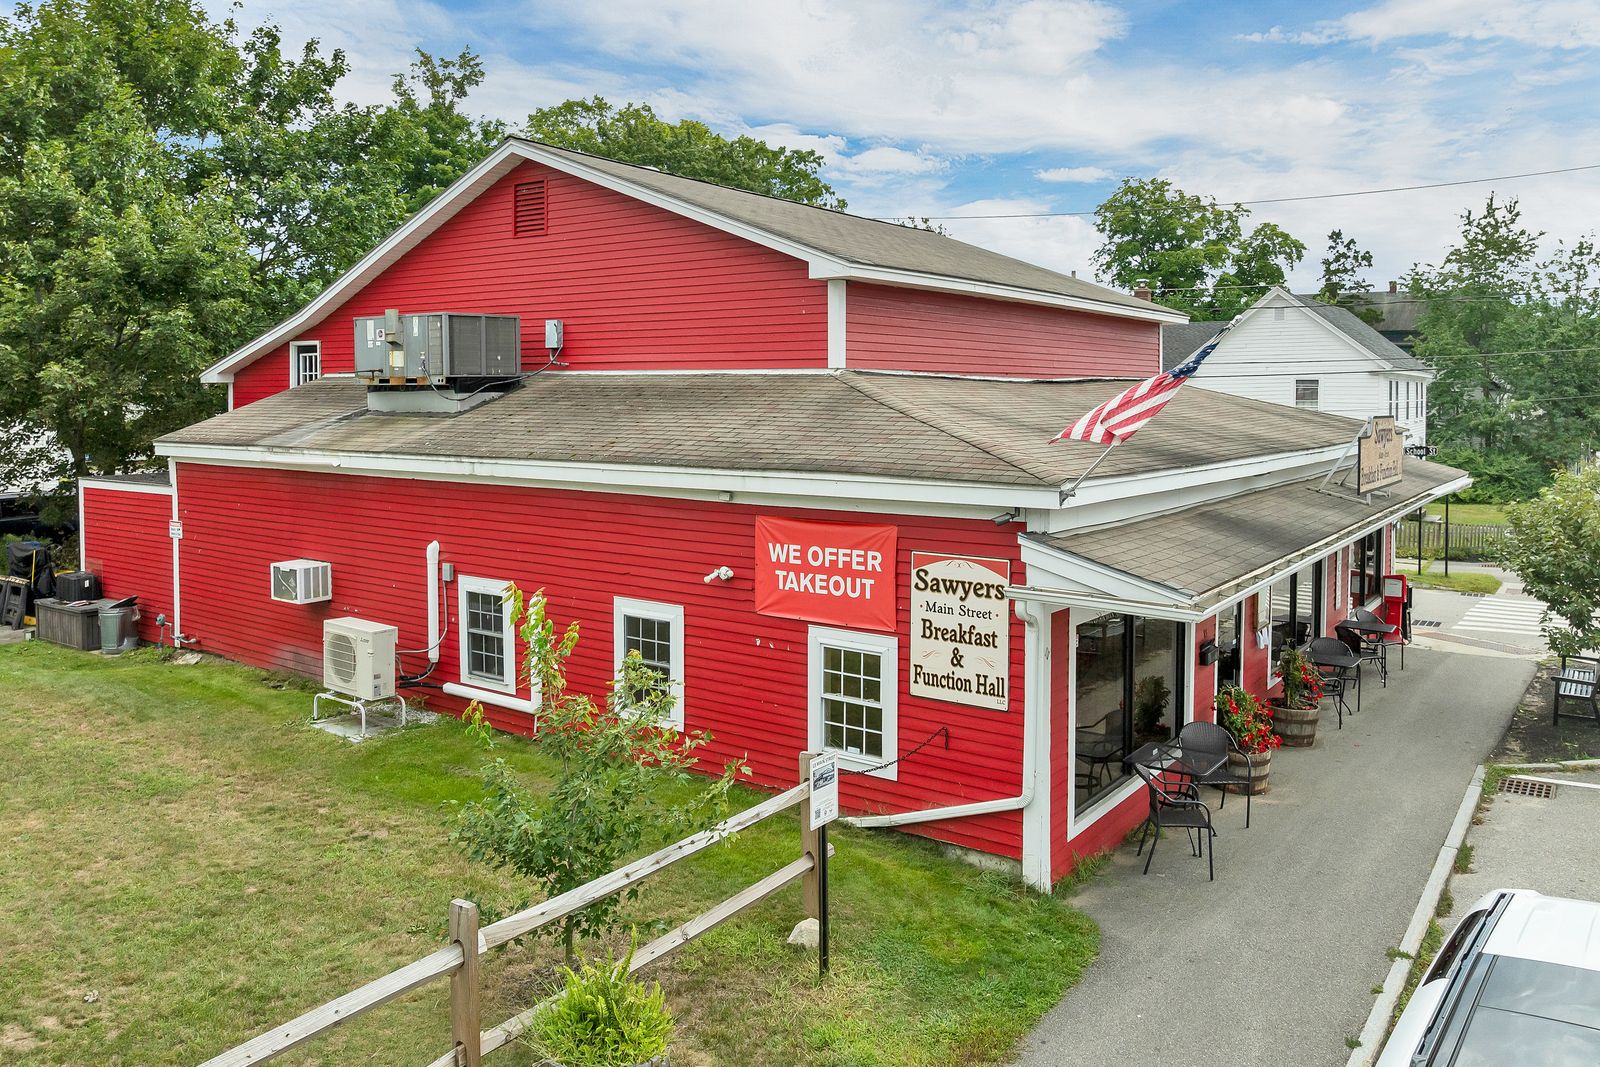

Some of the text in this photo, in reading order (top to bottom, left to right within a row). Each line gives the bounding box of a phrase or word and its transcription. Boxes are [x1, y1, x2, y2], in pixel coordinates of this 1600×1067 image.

[1375, 421, 1393, 448] Sawyers
[1406, 447, 1436, 456] School St
[768, 542, 883, 573] WE OFFER
[775, 570, 875, 600] TAKEOUT
[913, 568, 1006, 601] Sawyers
[925, 600, 993, 620] Main Street
[920, 618, 998, 649] Breakfast
[950, 647, 964, 668] &
[913, 664, 1006, 698] Function Hall
[996, 698, 1006, 706] LLC
